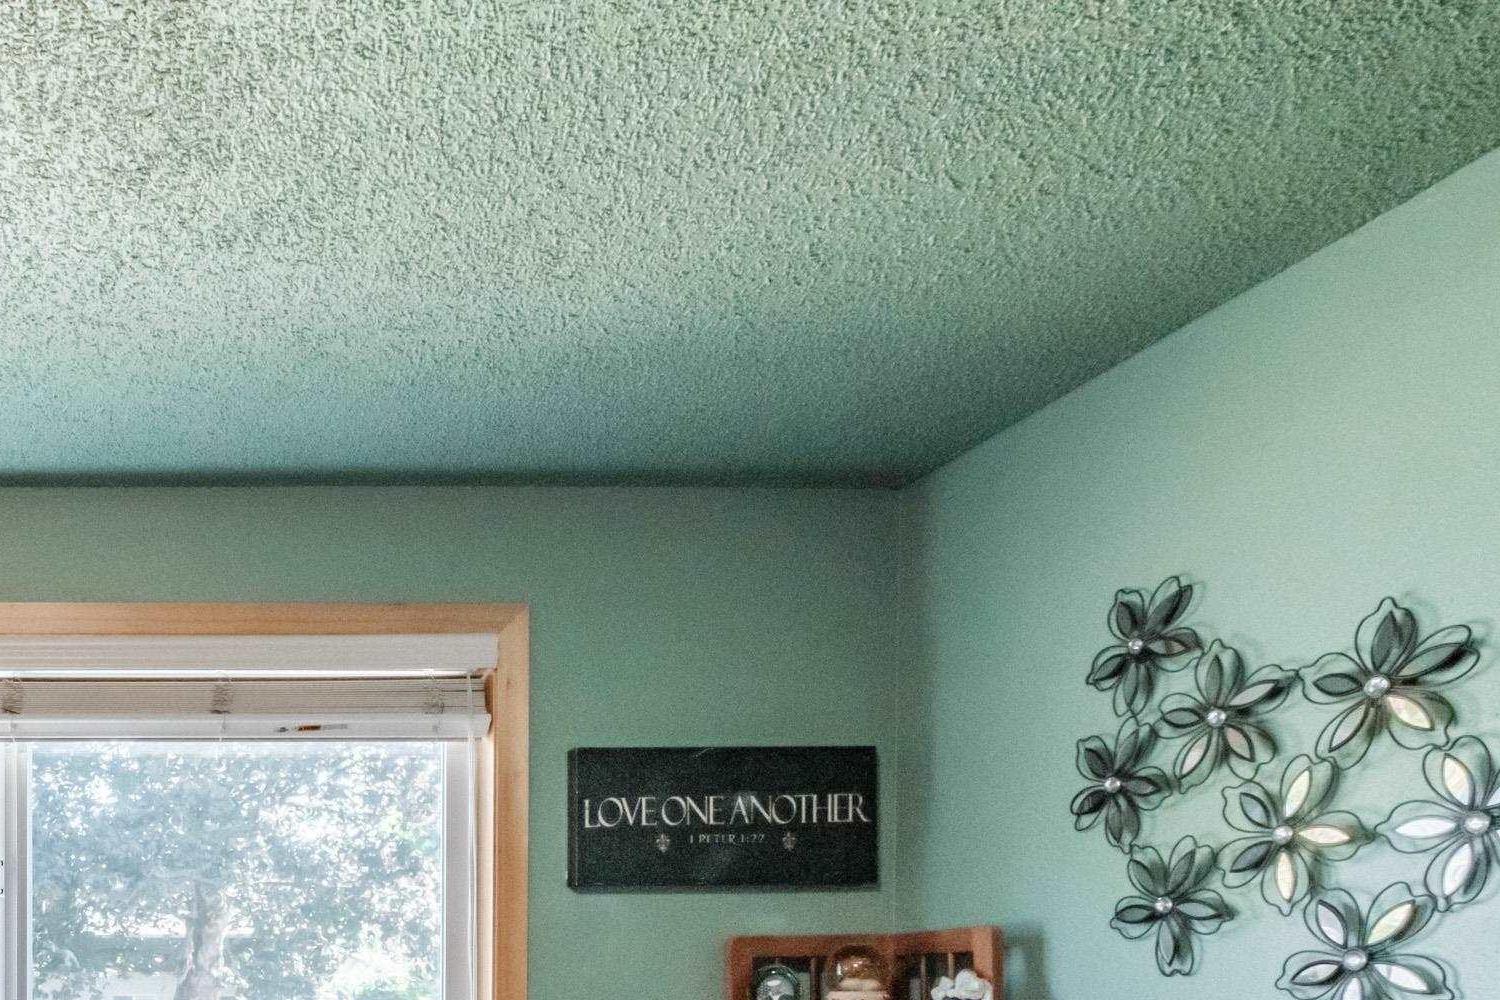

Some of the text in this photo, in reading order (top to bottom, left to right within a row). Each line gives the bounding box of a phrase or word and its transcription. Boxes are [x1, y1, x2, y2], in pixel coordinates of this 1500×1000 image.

[584, 793, 872, 828] LOVE ONE ANOTHER
